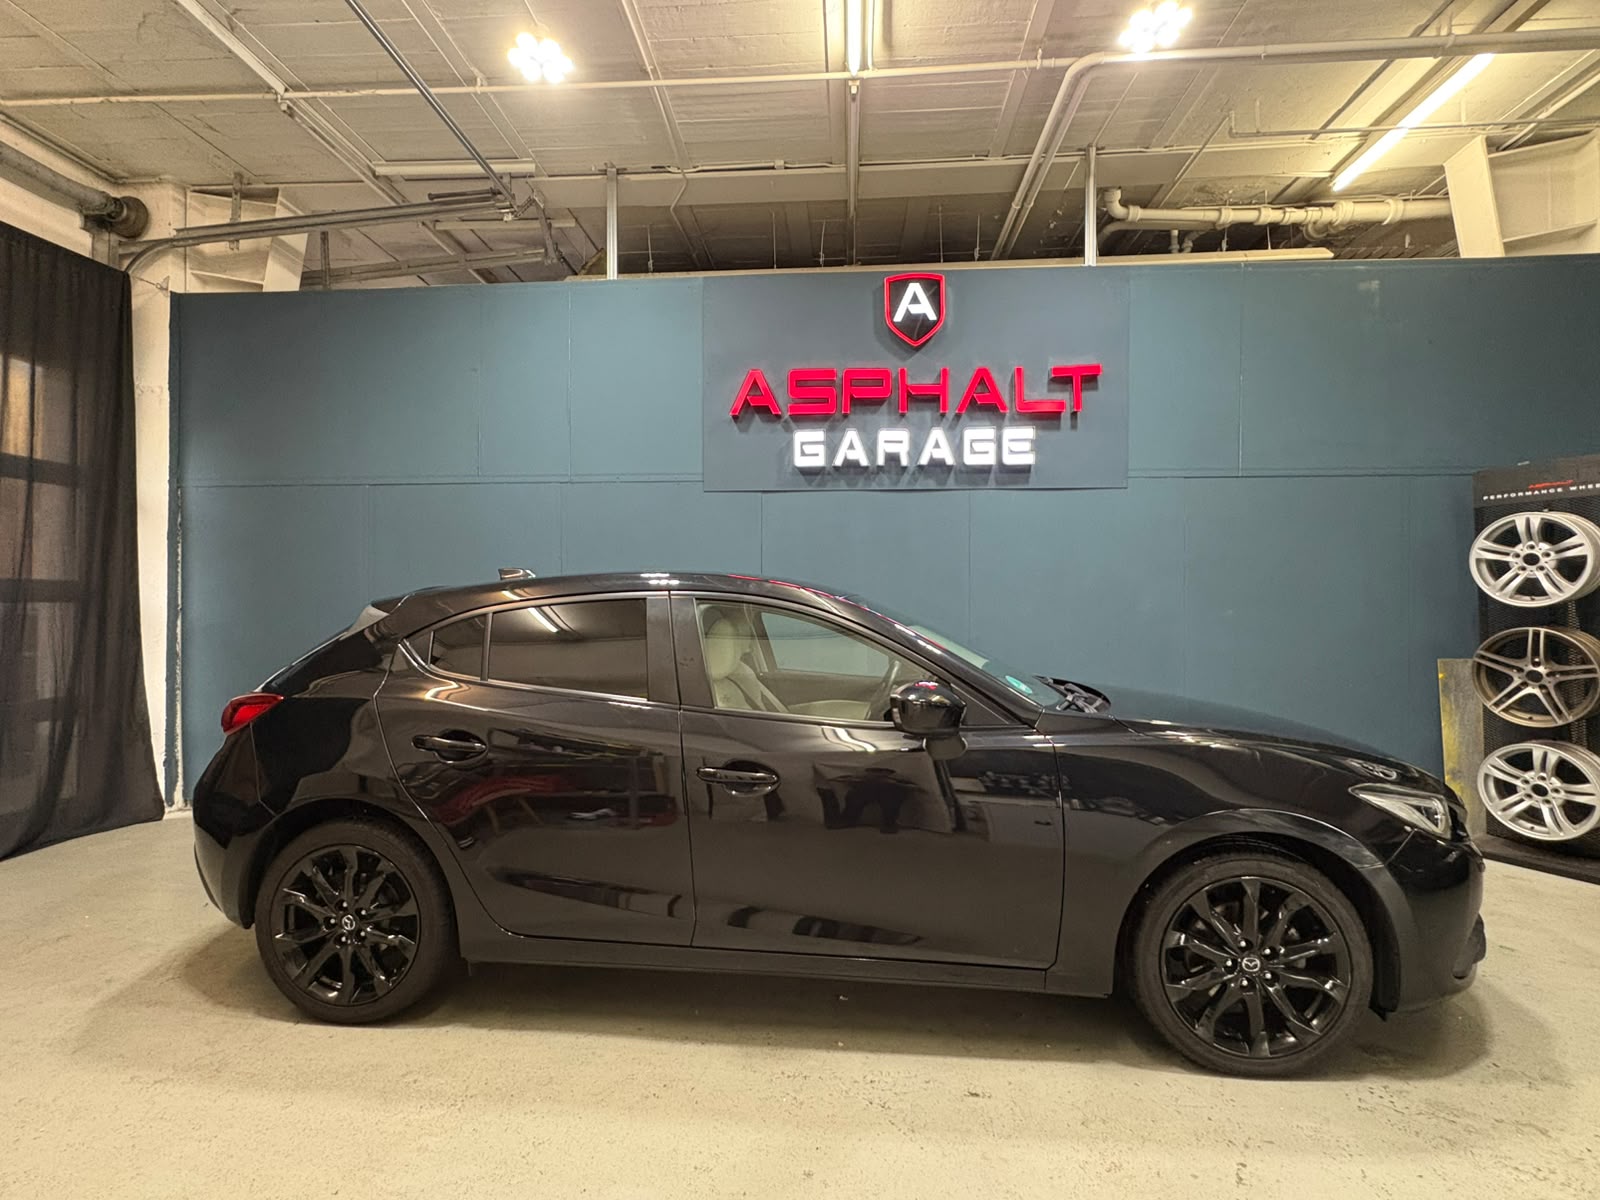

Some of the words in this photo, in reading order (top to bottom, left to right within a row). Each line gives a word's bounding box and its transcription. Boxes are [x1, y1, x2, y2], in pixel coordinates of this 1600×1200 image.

[893, 282, 938, 323] A
[729, 363, 1103, 417] ASPHALT
[793, 425, 1036, 468] GARAGE
[1482, 487, 1563, 501] PERFORMANCE
